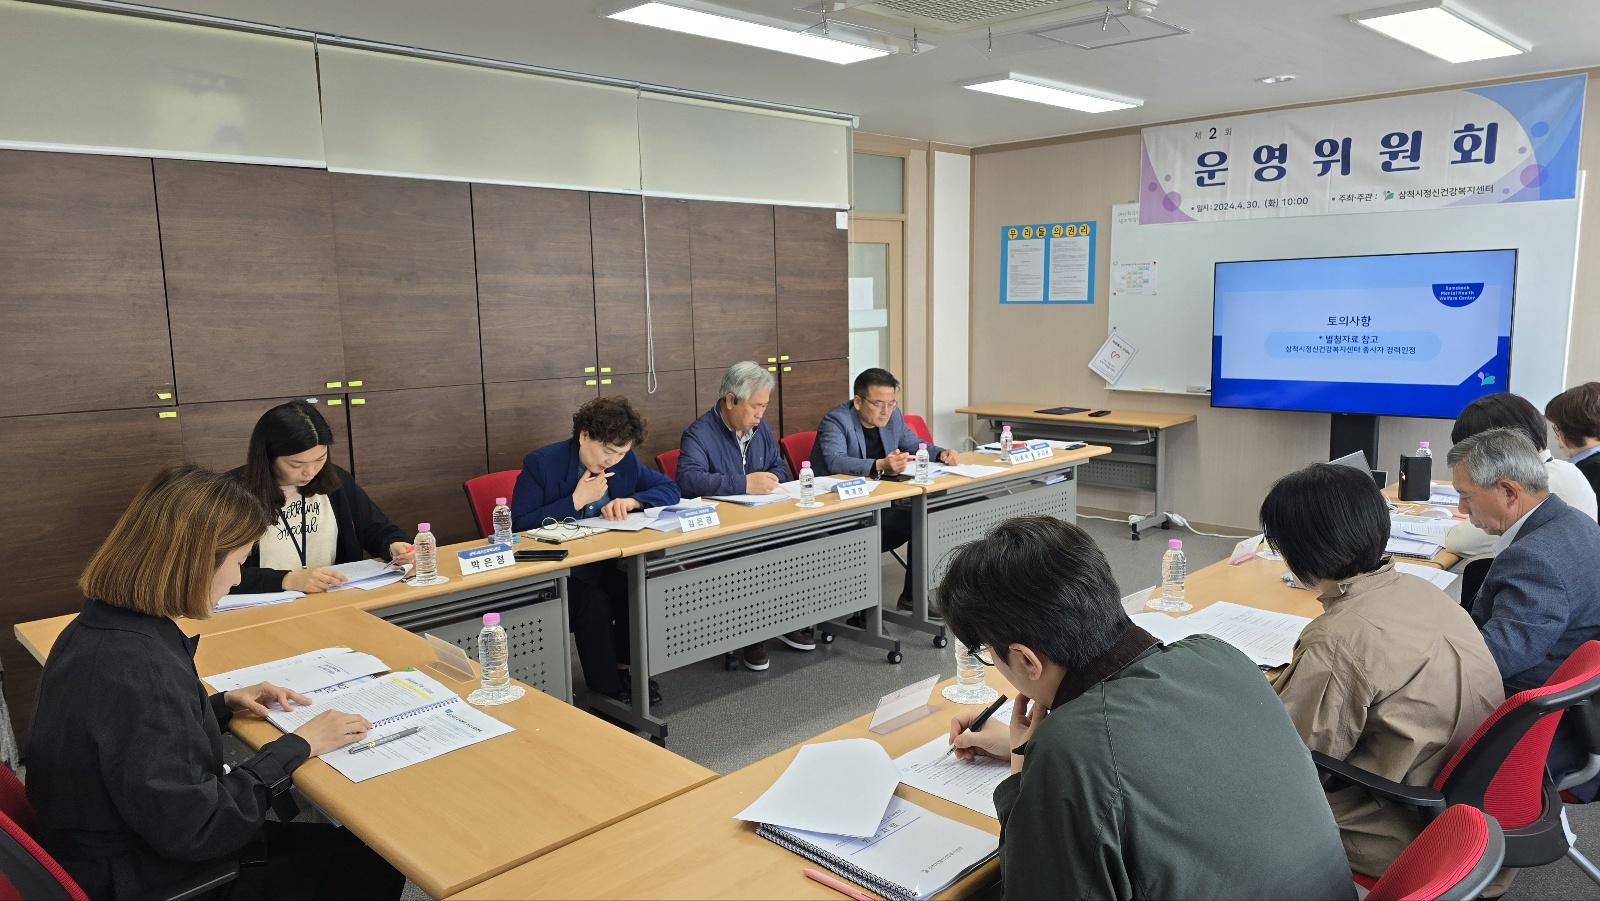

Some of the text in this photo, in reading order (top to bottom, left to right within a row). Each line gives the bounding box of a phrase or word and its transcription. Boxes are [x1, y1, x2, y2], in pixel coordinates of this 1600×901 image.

[1208, 127, 1217, 139] 2
[1398, 184, 1494, 200] 삼척시정신건강복지센터
[1281, 197, 1309, 206] 10:00
[1327, 315, 1372, 327] 토의사항
[1361, 335, 1379, 344] 참고
[1285, 345, 1361, 354] 삼척시정신건강복지센터
[471, 555, 505, 569] 박은정
